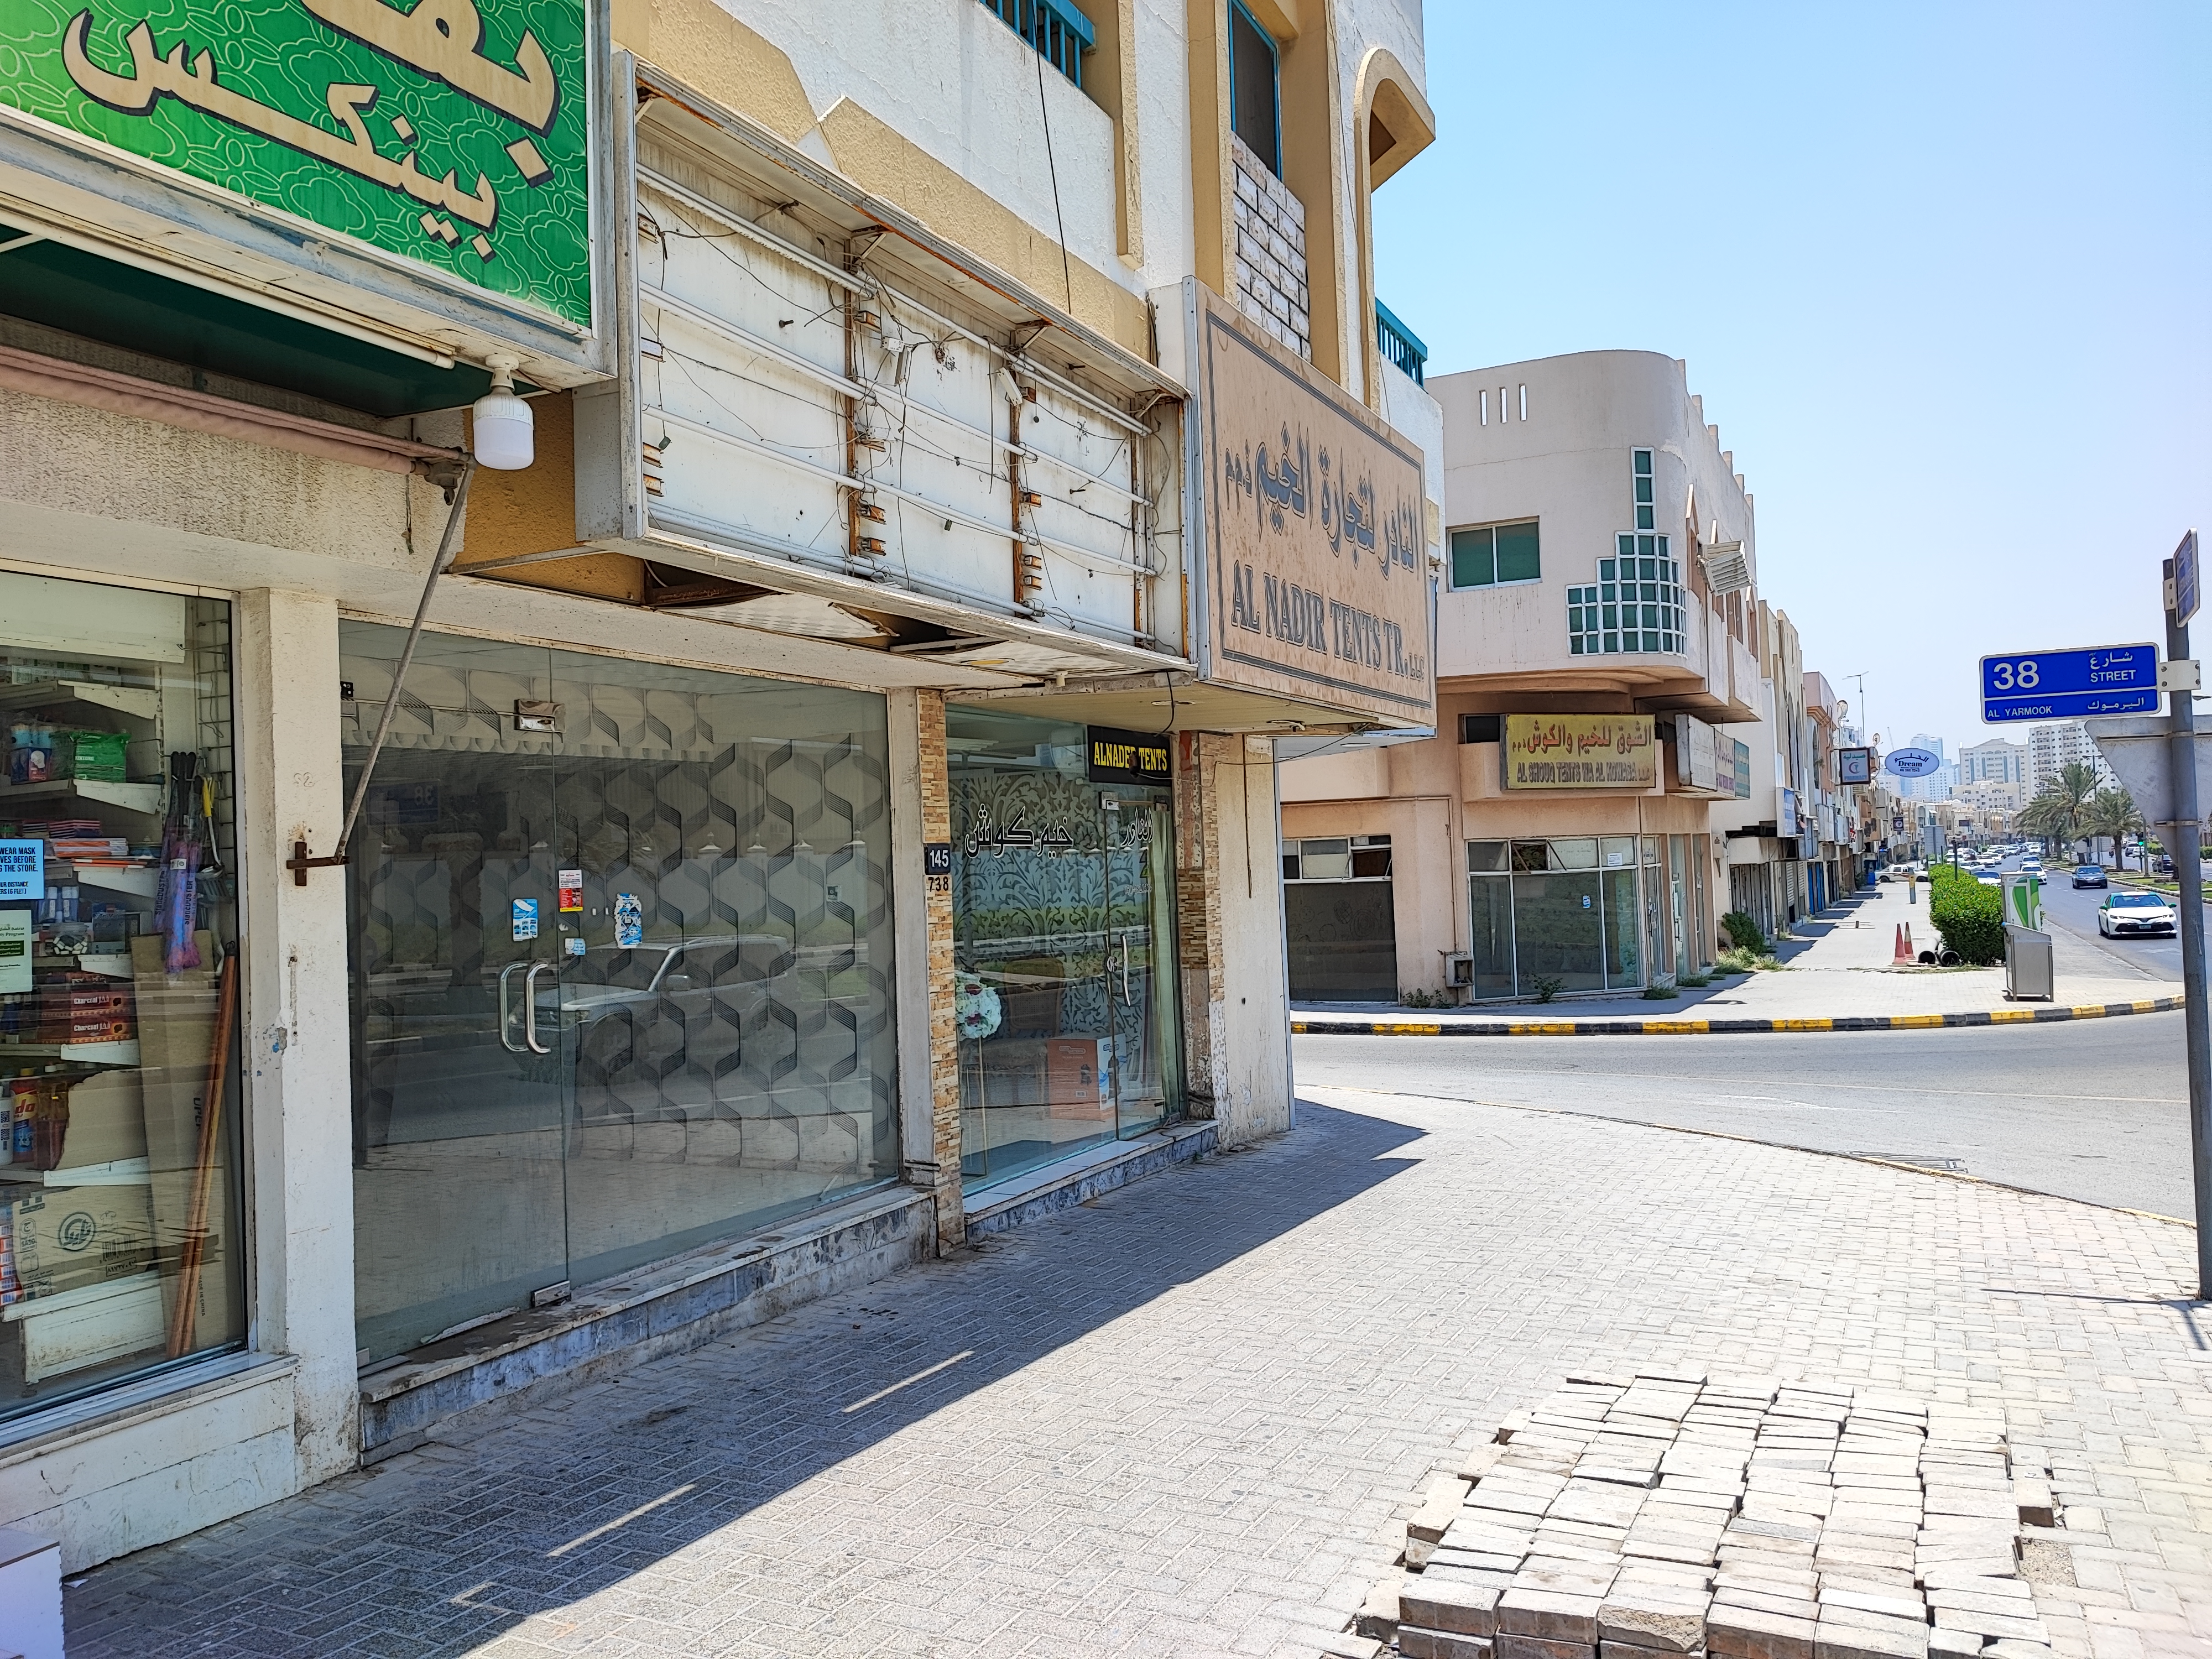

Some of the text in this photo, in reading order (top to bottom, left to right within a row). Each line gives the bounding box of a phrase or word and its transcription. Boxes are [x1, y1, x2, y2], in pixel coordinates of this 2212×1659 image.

[1255, 420, 1314, 543] الخيم
[1318, 444, 1376, 570] لتجارة
[1378, 483, 1420, 581] النادر
[1231, 559, 1261, 634] AL
[1264, 572, 1328, 656] NADIR
[1329, 597, 1381, 671] TENTS
[1993, 660, 2040, 690] 38
[2089, 651, 2133, 670] شارع
[2090, 669, 2137, 684] STREET
[1987, 705, 2053, 718] AL YARMOOK
[2087, 697, 2145, 712] اليرموك
[1527, 719, 1573, 754] والكوش
[1577, 724, 1611, 757] للخيم
[1616, 721, 1652, 754] الشوق
[1138, 747, 1167, 771] TENTS
[1843, 752, 1866, 760] صيدلية
[1517, 761, 1528, 783] AL
[1528, 761, 1556, 784] SHOUQ
[1556, 761, 1580, 782] TENTS
[1582, 761, 1594, 782] WA
[1595, 761, 1605, 782] AL
[964, 803, 1036, 859] كوش
[1036, 816, 1074, 859] خيم
[930, 849, 949, 868] 145
[928, 876, 949, 892] 738
